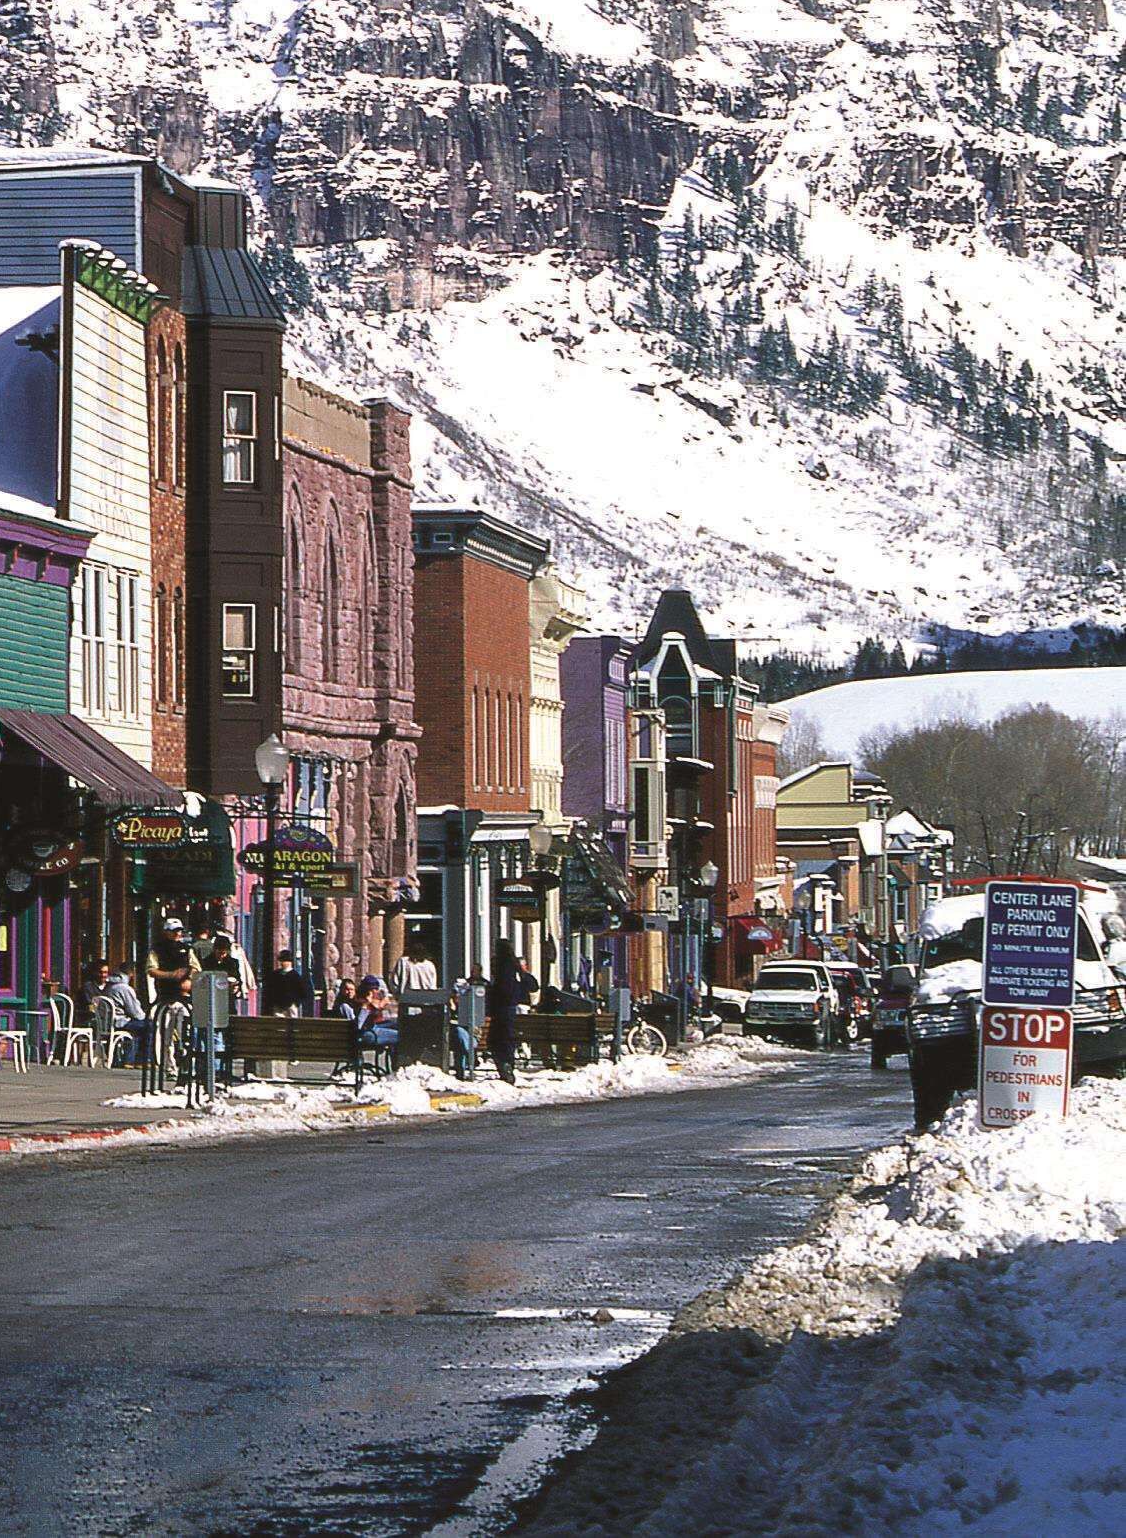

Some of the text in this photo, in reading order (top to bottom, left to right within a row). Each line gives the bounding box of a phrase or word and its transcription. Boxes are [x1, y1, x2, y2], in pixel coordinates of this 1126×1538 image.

[123, 817, 183, 842] Picaya
[273, 850, 332, 863] ARAGON
[288, 863, 296, 871] &
[992, 892, 1072, 908] CENTER LANE
[1007, 908, 1056, 922] PARKING
[991, 923, 1071, 938] BY PERMIT ONLY
[1004, 944, 1031, 953] MINUTE
[1033, 946, 1070, 954] MAXIMUM
[991, 966, 1069, 977] ALL OTHERS SUBJECT TO
[1056, 979, 1070, 988] AND
[988, 1012, 1065, 1043] STOP
[1013, 1054, 1037, 1067] FOR
[986, 1071, 1063, 1087] PEDESTRIANS
[1017, 1091, 1030, 1103] IN
